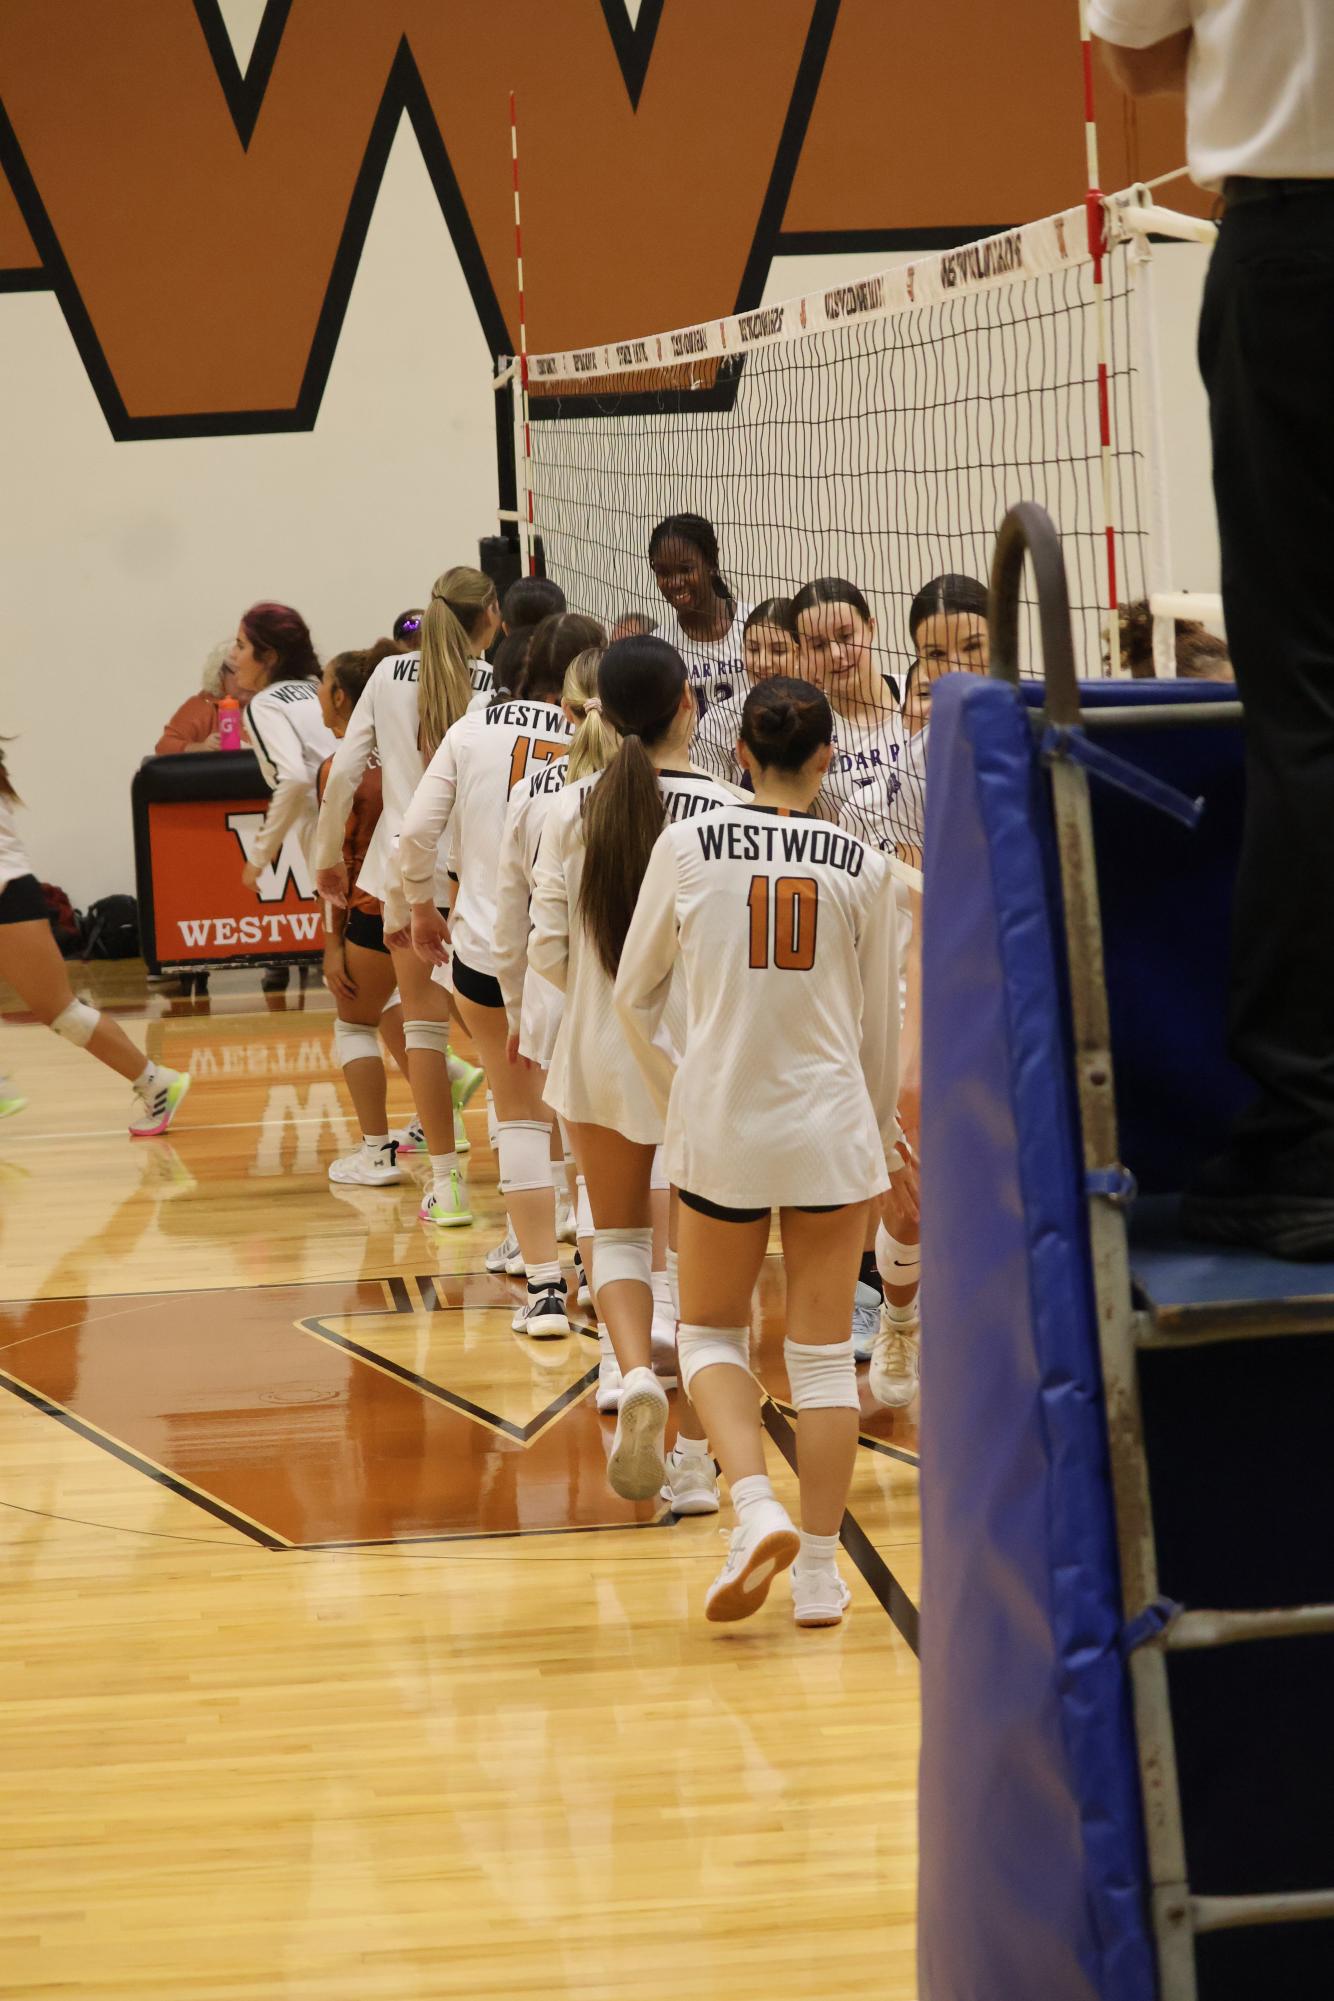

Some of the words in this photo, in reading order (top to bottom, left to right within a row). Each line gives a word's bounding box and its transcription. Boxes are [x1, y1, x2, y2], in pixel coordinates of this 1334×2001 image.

[221, 718, 233, 733] G
[697, 823, 865, 878] WESTWOOD
[747, 875, 819, 971] 10
